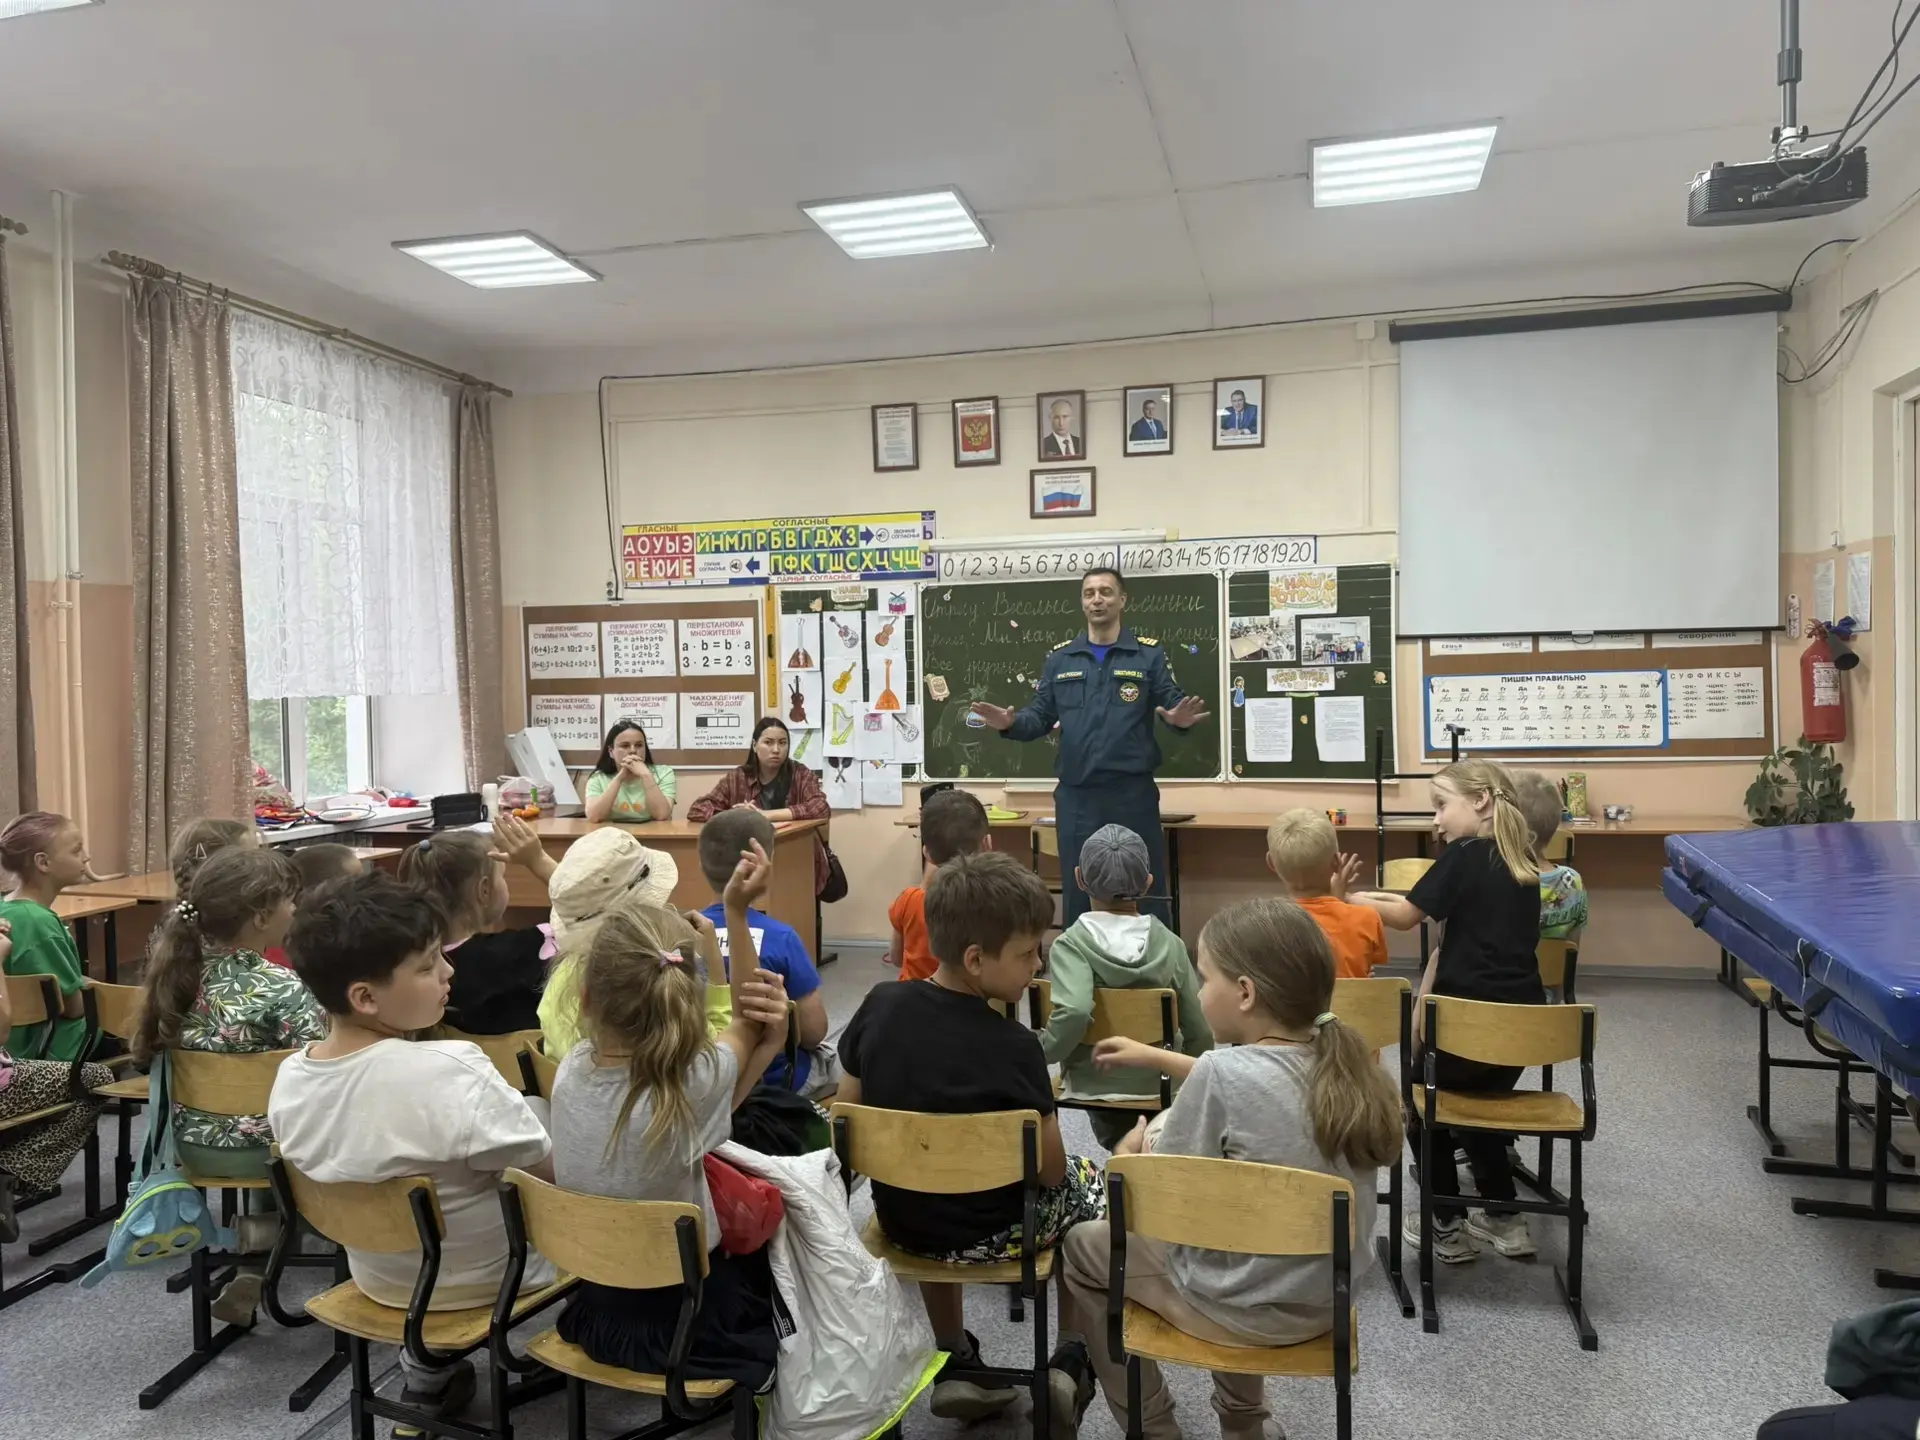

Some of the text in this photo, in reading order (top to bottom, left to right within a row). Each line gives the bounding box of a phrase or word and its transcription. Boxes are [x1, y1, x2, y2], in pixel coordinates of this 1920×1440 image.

[772, 518, 830, 527] СОГЛАСНЫЕ
[638, 525, 678, 533] ГЛАСНЫЕ
[1122, 542, 1312, 569] 11 12 13 14 15 16 17 18 19 20
[943, 558, 954, 577] 0
[959, 557, 967, 577] 1
[970, 557, 982, 576] 2
[987, 556, 998, 576] 3
[1003, 555, 1014, 575] 4
[1019, 555, 1031, 574] 5
[1036, 554, 1048, 574] 6
[1051, 553, 1063, 573] 7
[1066, 553, 1078, 572] 8
[1083, 552, 1094, 572] 9
[1098, 551, 1114, 570] 10
[686, 621, 745, 629] ПЕРЕСТАНОВКА
[690, 628, 742, 636] МНОЖИТЕЛЕЙ
[682, 656, 690, 668] 3
[702, 656, 709, 667] 2
[725, 655, 733, 667] 2
[744, 655, 752, 666] 3
[1670, 671, 1741, 680] СУФФИКСЫ
